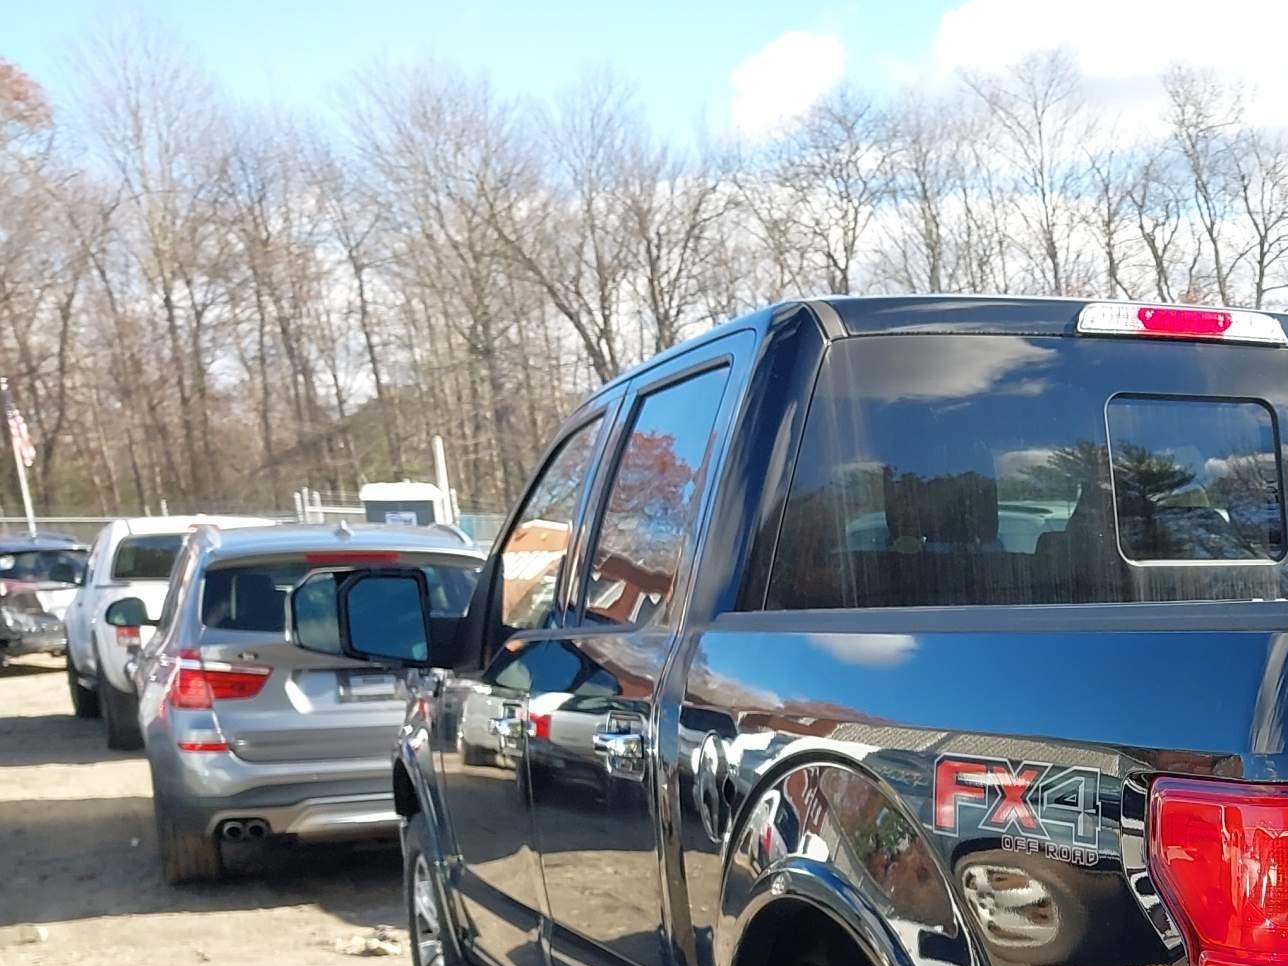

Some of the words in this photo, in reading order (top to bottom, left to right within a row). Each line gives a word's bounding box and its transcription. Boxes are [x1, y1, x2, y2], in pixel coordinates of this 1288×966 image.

[933, 752, 1101, 847] FX4
[1002, 835, 1039, 855] OFF
[1046, 842, 1099, 866] ROAD
